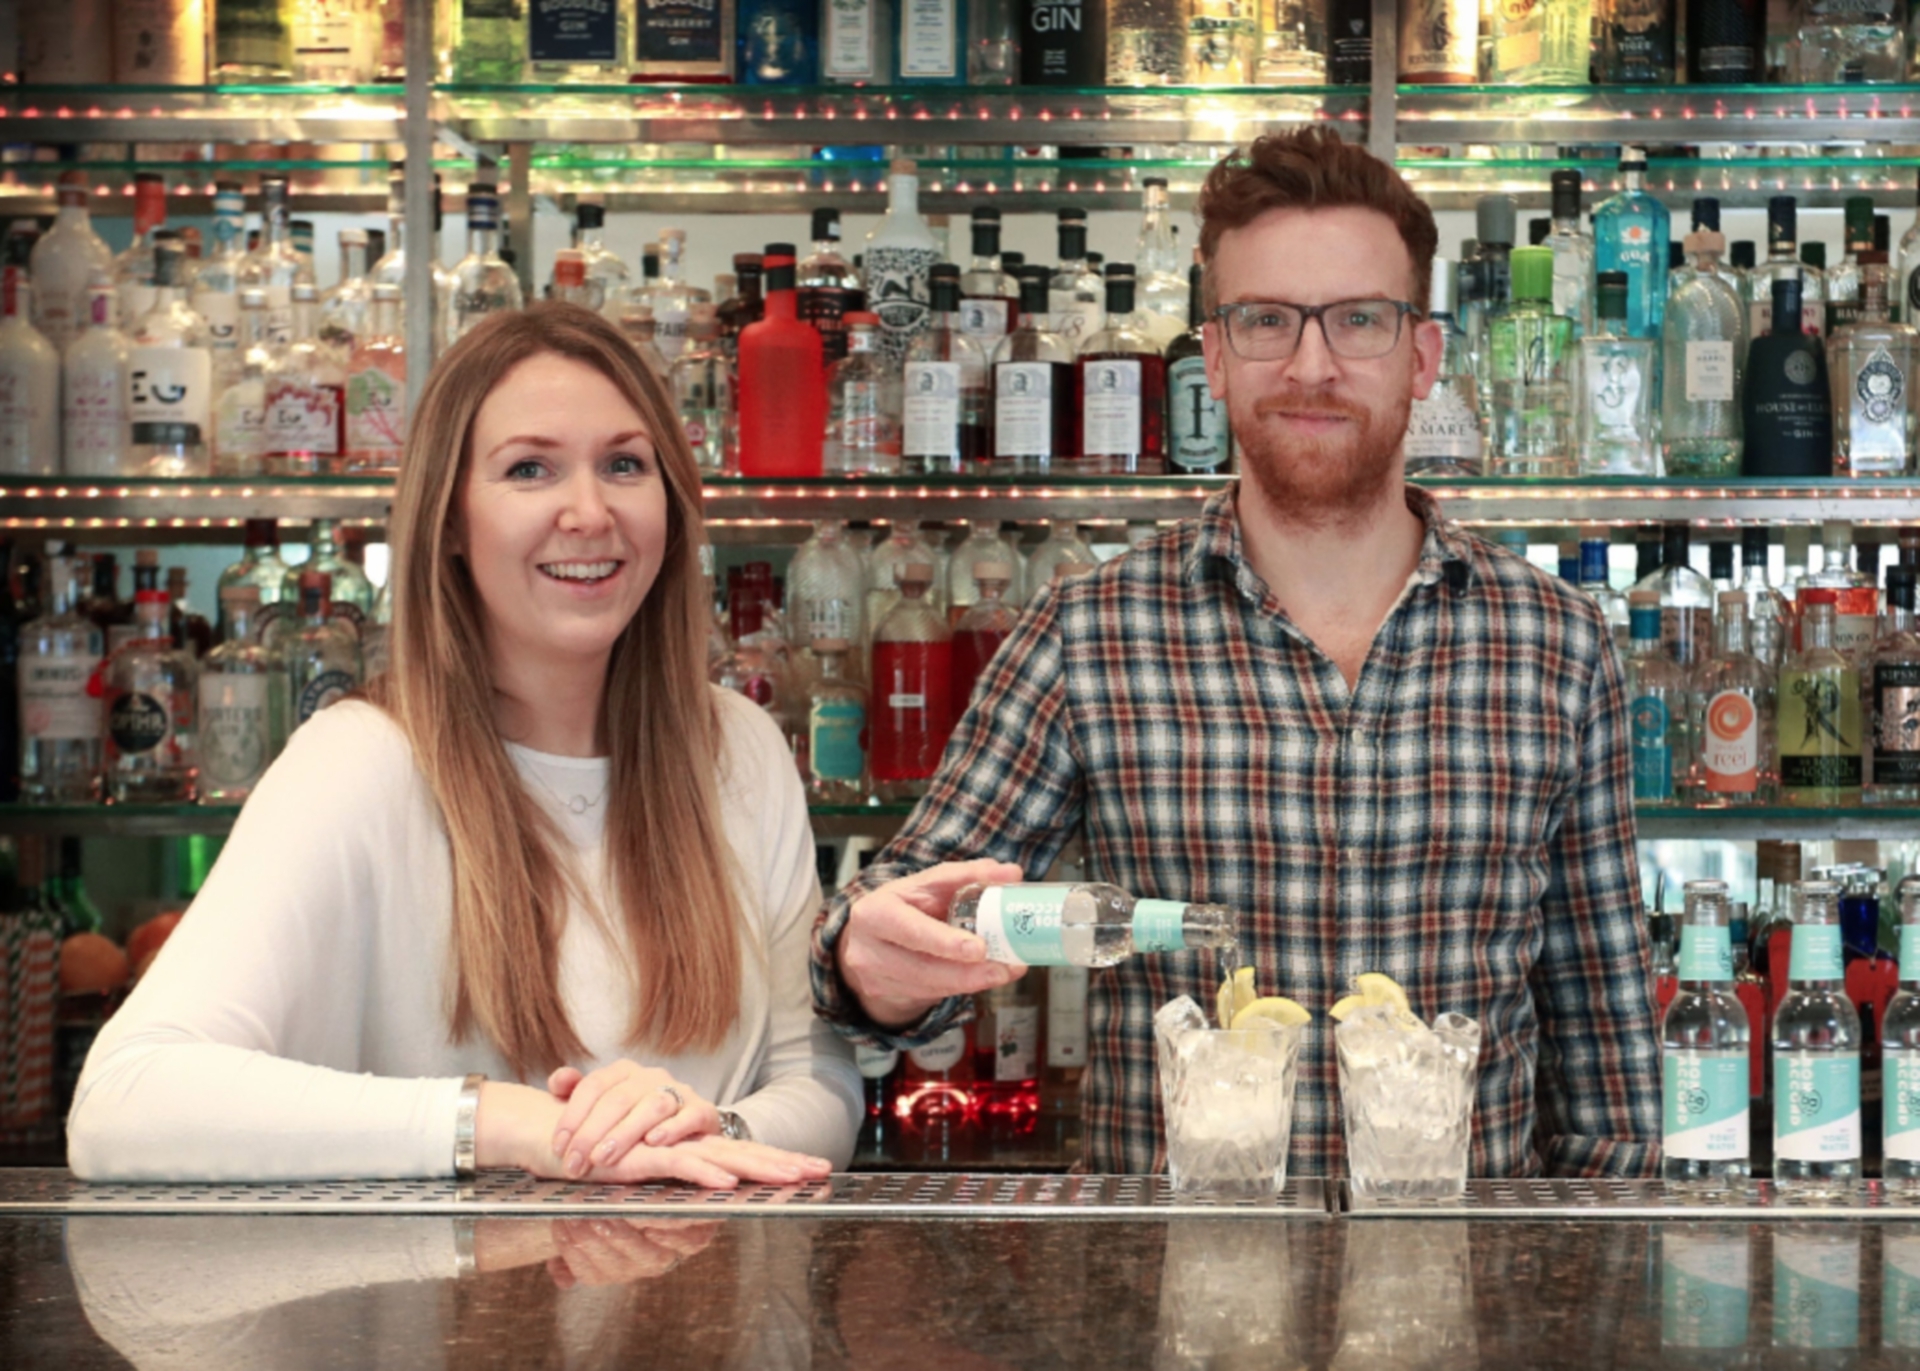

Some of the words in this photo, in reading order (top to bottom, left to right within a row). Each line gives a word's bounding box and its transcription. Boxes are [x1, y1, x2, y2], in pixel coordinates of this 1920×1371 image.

[1032, 7, 1081, 31] GIN
[1420, 423, 1467, 437] MARE
[1714, 755, 1747, 767] reel
[1677, 1056, 1689, 1126] ACCORD
[1790, 1057, 1802, 1127] ACCORD
[1897, 1057, 1909, 1127] ACCORD
[1709, 1133, 1737, 1142] TONIC
[1822, 1134, 1850, 1143] TONIC
[1707, 1142, 1737, 1151] WATER
[1819, 1143, 1850, 1152] WATER
